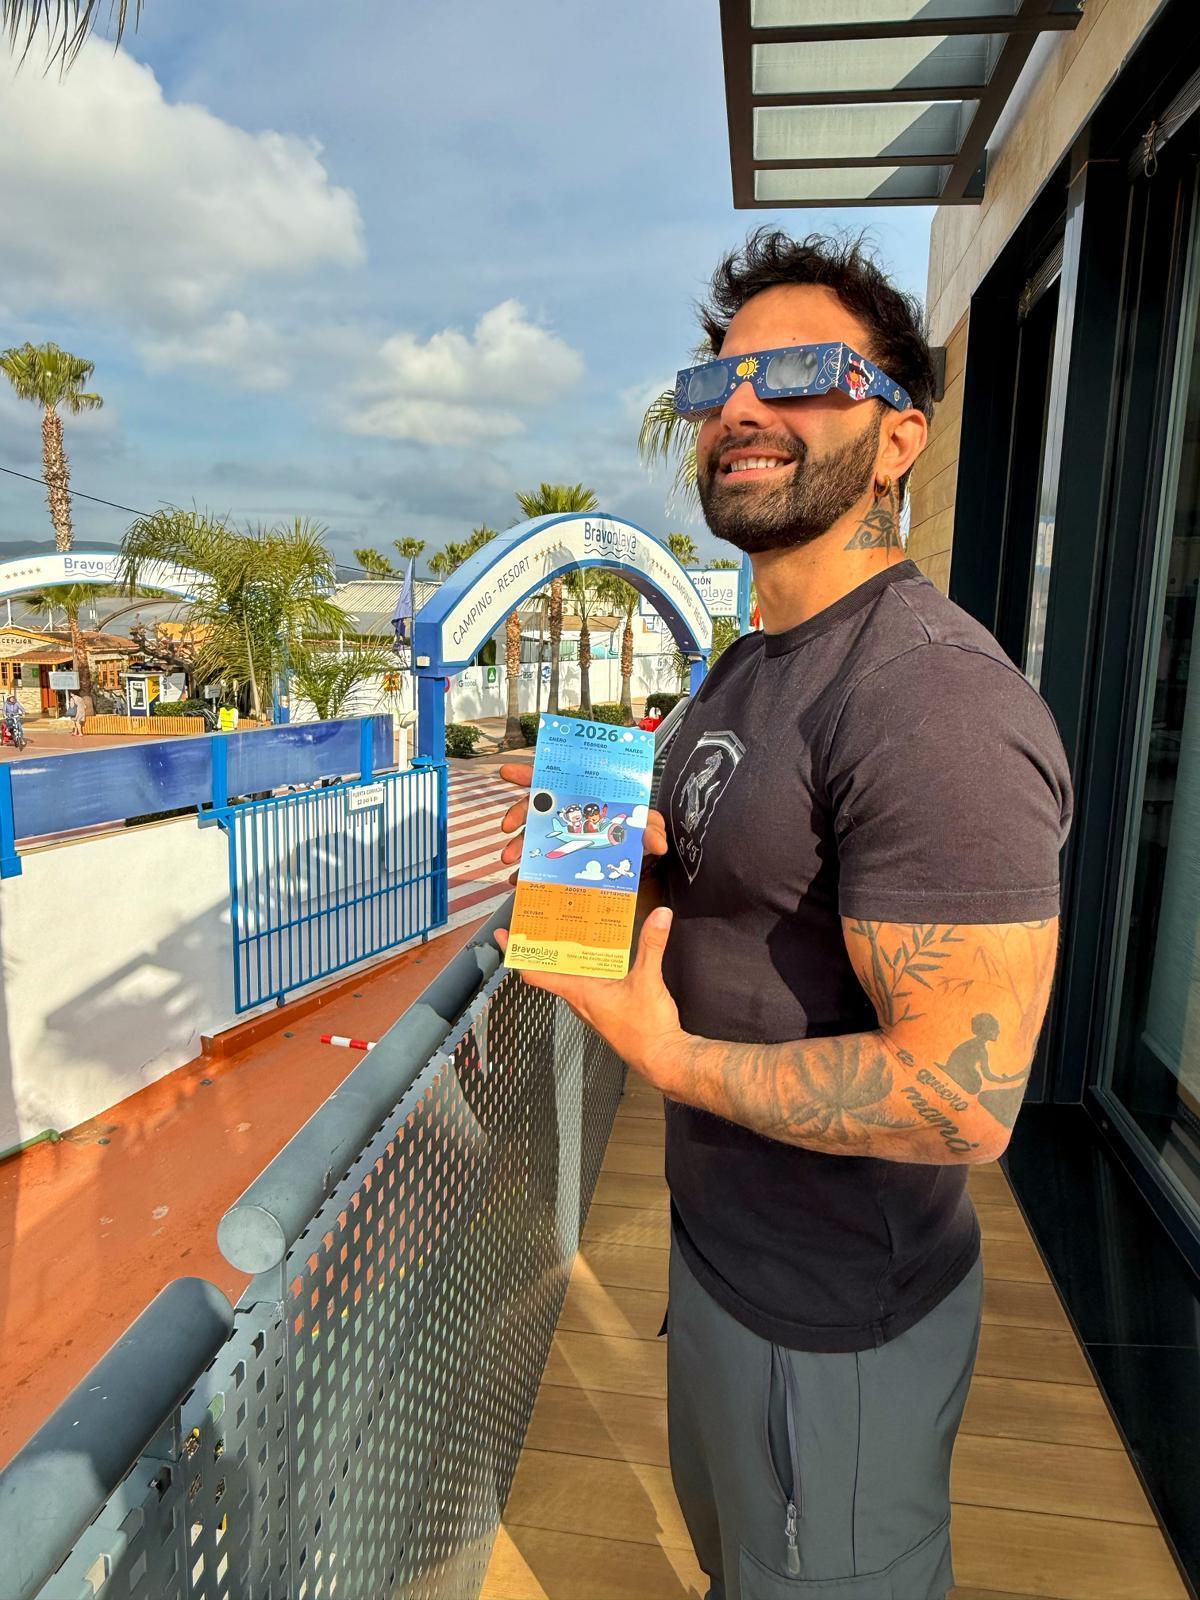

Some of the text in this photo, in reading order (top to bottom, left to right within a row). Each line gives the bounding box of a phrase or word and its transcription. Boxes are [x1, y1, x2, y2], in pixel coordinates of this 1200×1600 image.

[584, 521, 637, 553] Bravoplaya
[453, 591, 493, 645] CAMPING
[497, 556, 530, 592] RESORT
[575, 723, 618, 742] 2026
[511, 943, 559, 957] Bravoplaya
